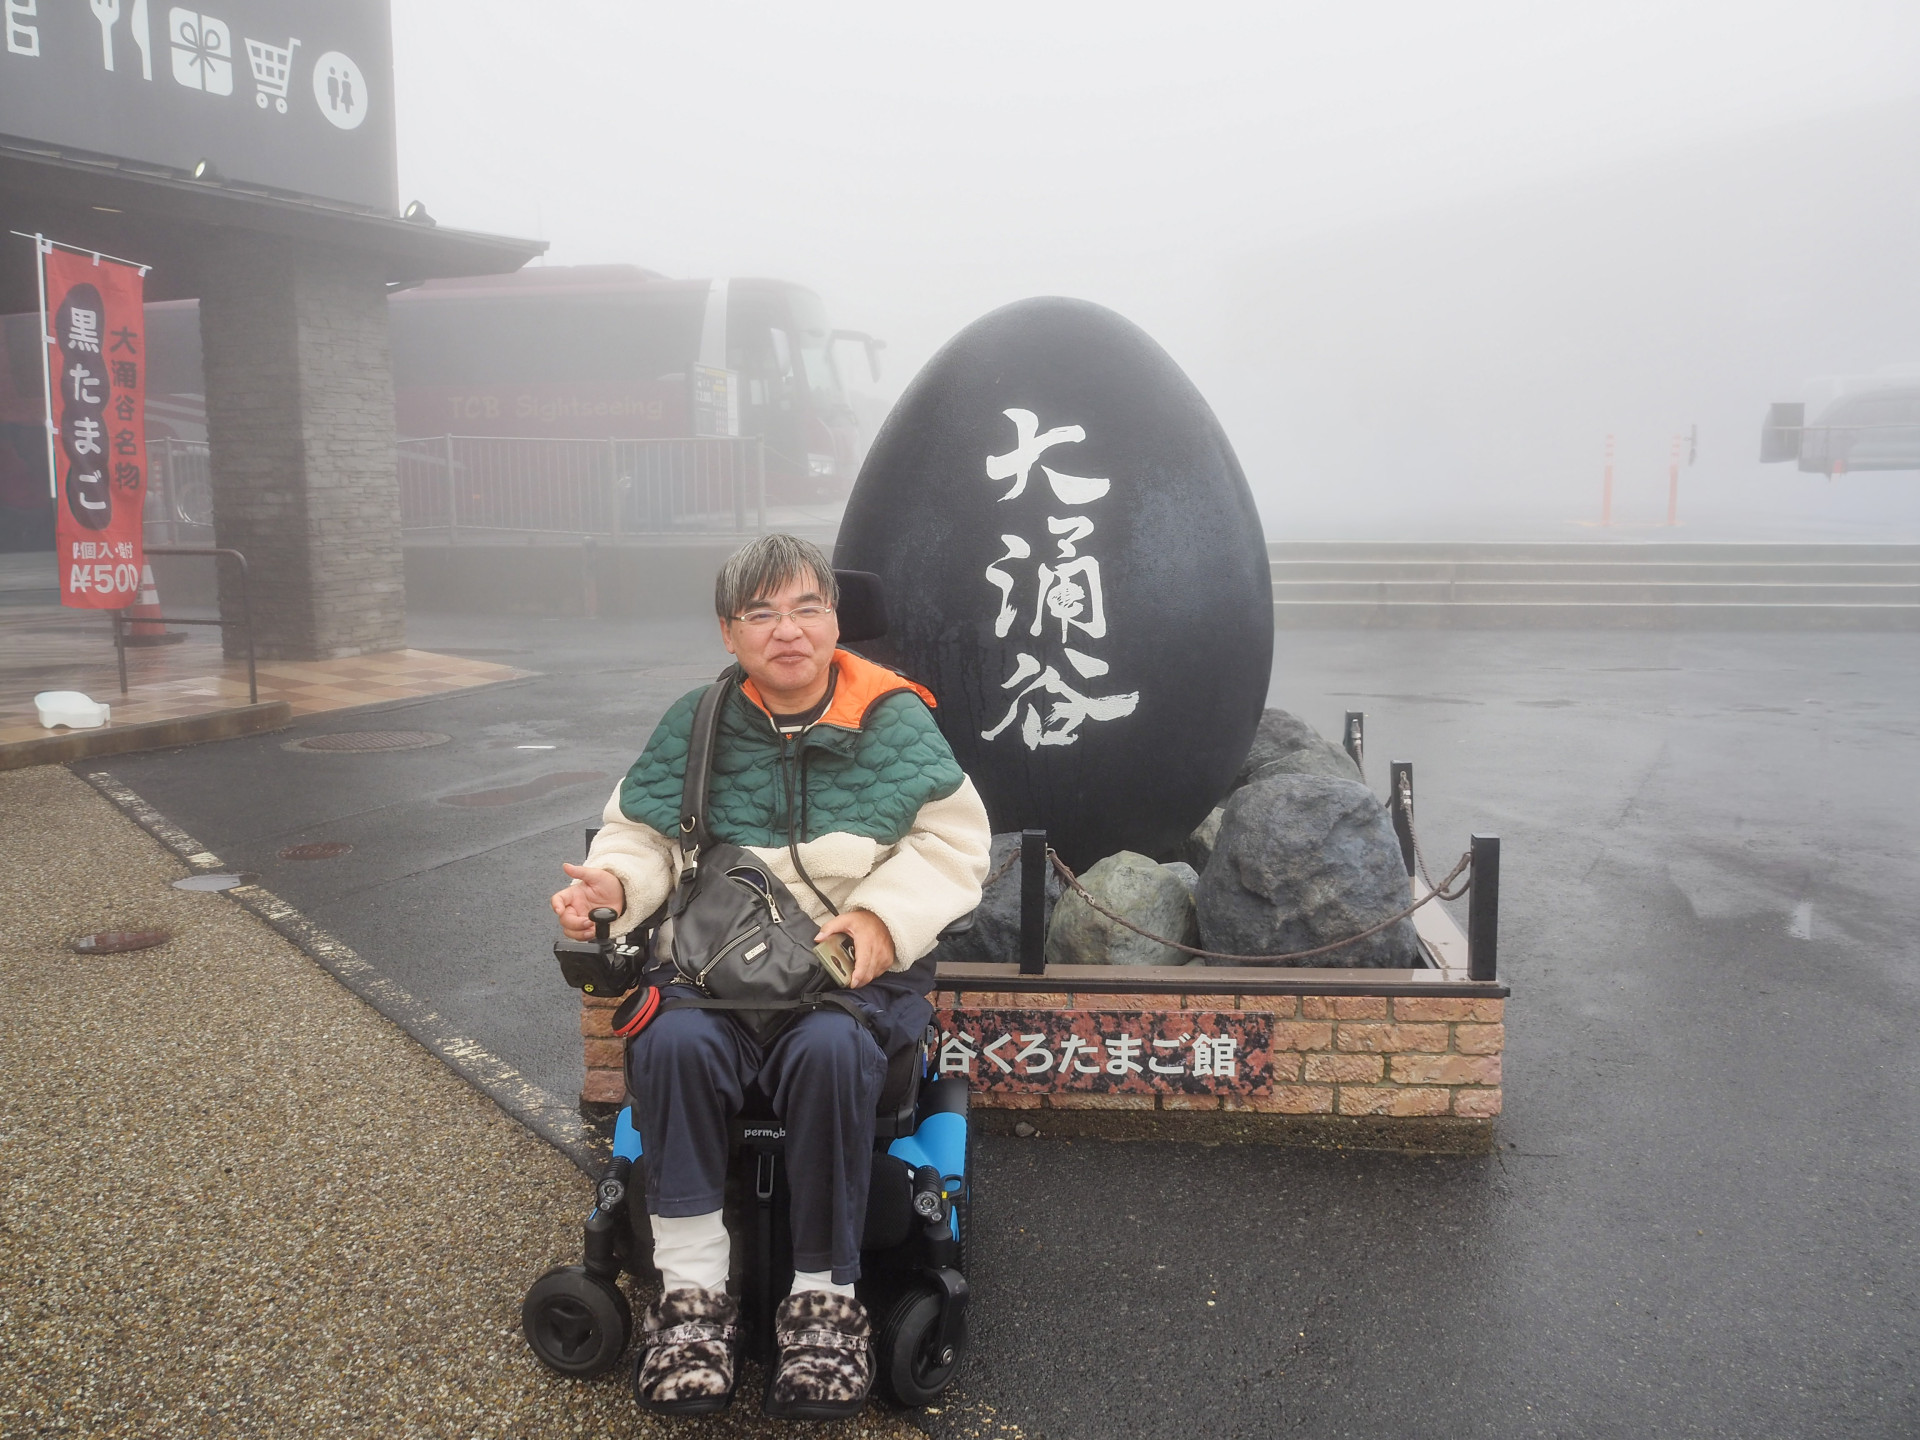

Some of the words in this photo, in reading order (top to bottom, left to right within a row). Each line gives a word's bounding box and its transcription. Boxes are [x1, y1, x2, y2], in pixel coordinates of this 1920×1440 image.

[69, 306, 106, 510] 黒たまご
[110, 325, 141, 490] 大涌谷名物
[447, 395, 501, 420] TCB
[515, 393, 663, 422] Sightseeing
[981, 408, 1140, 751] 大涌谷
[934, 1030, 1238, 1077] 谷くろたまご館
